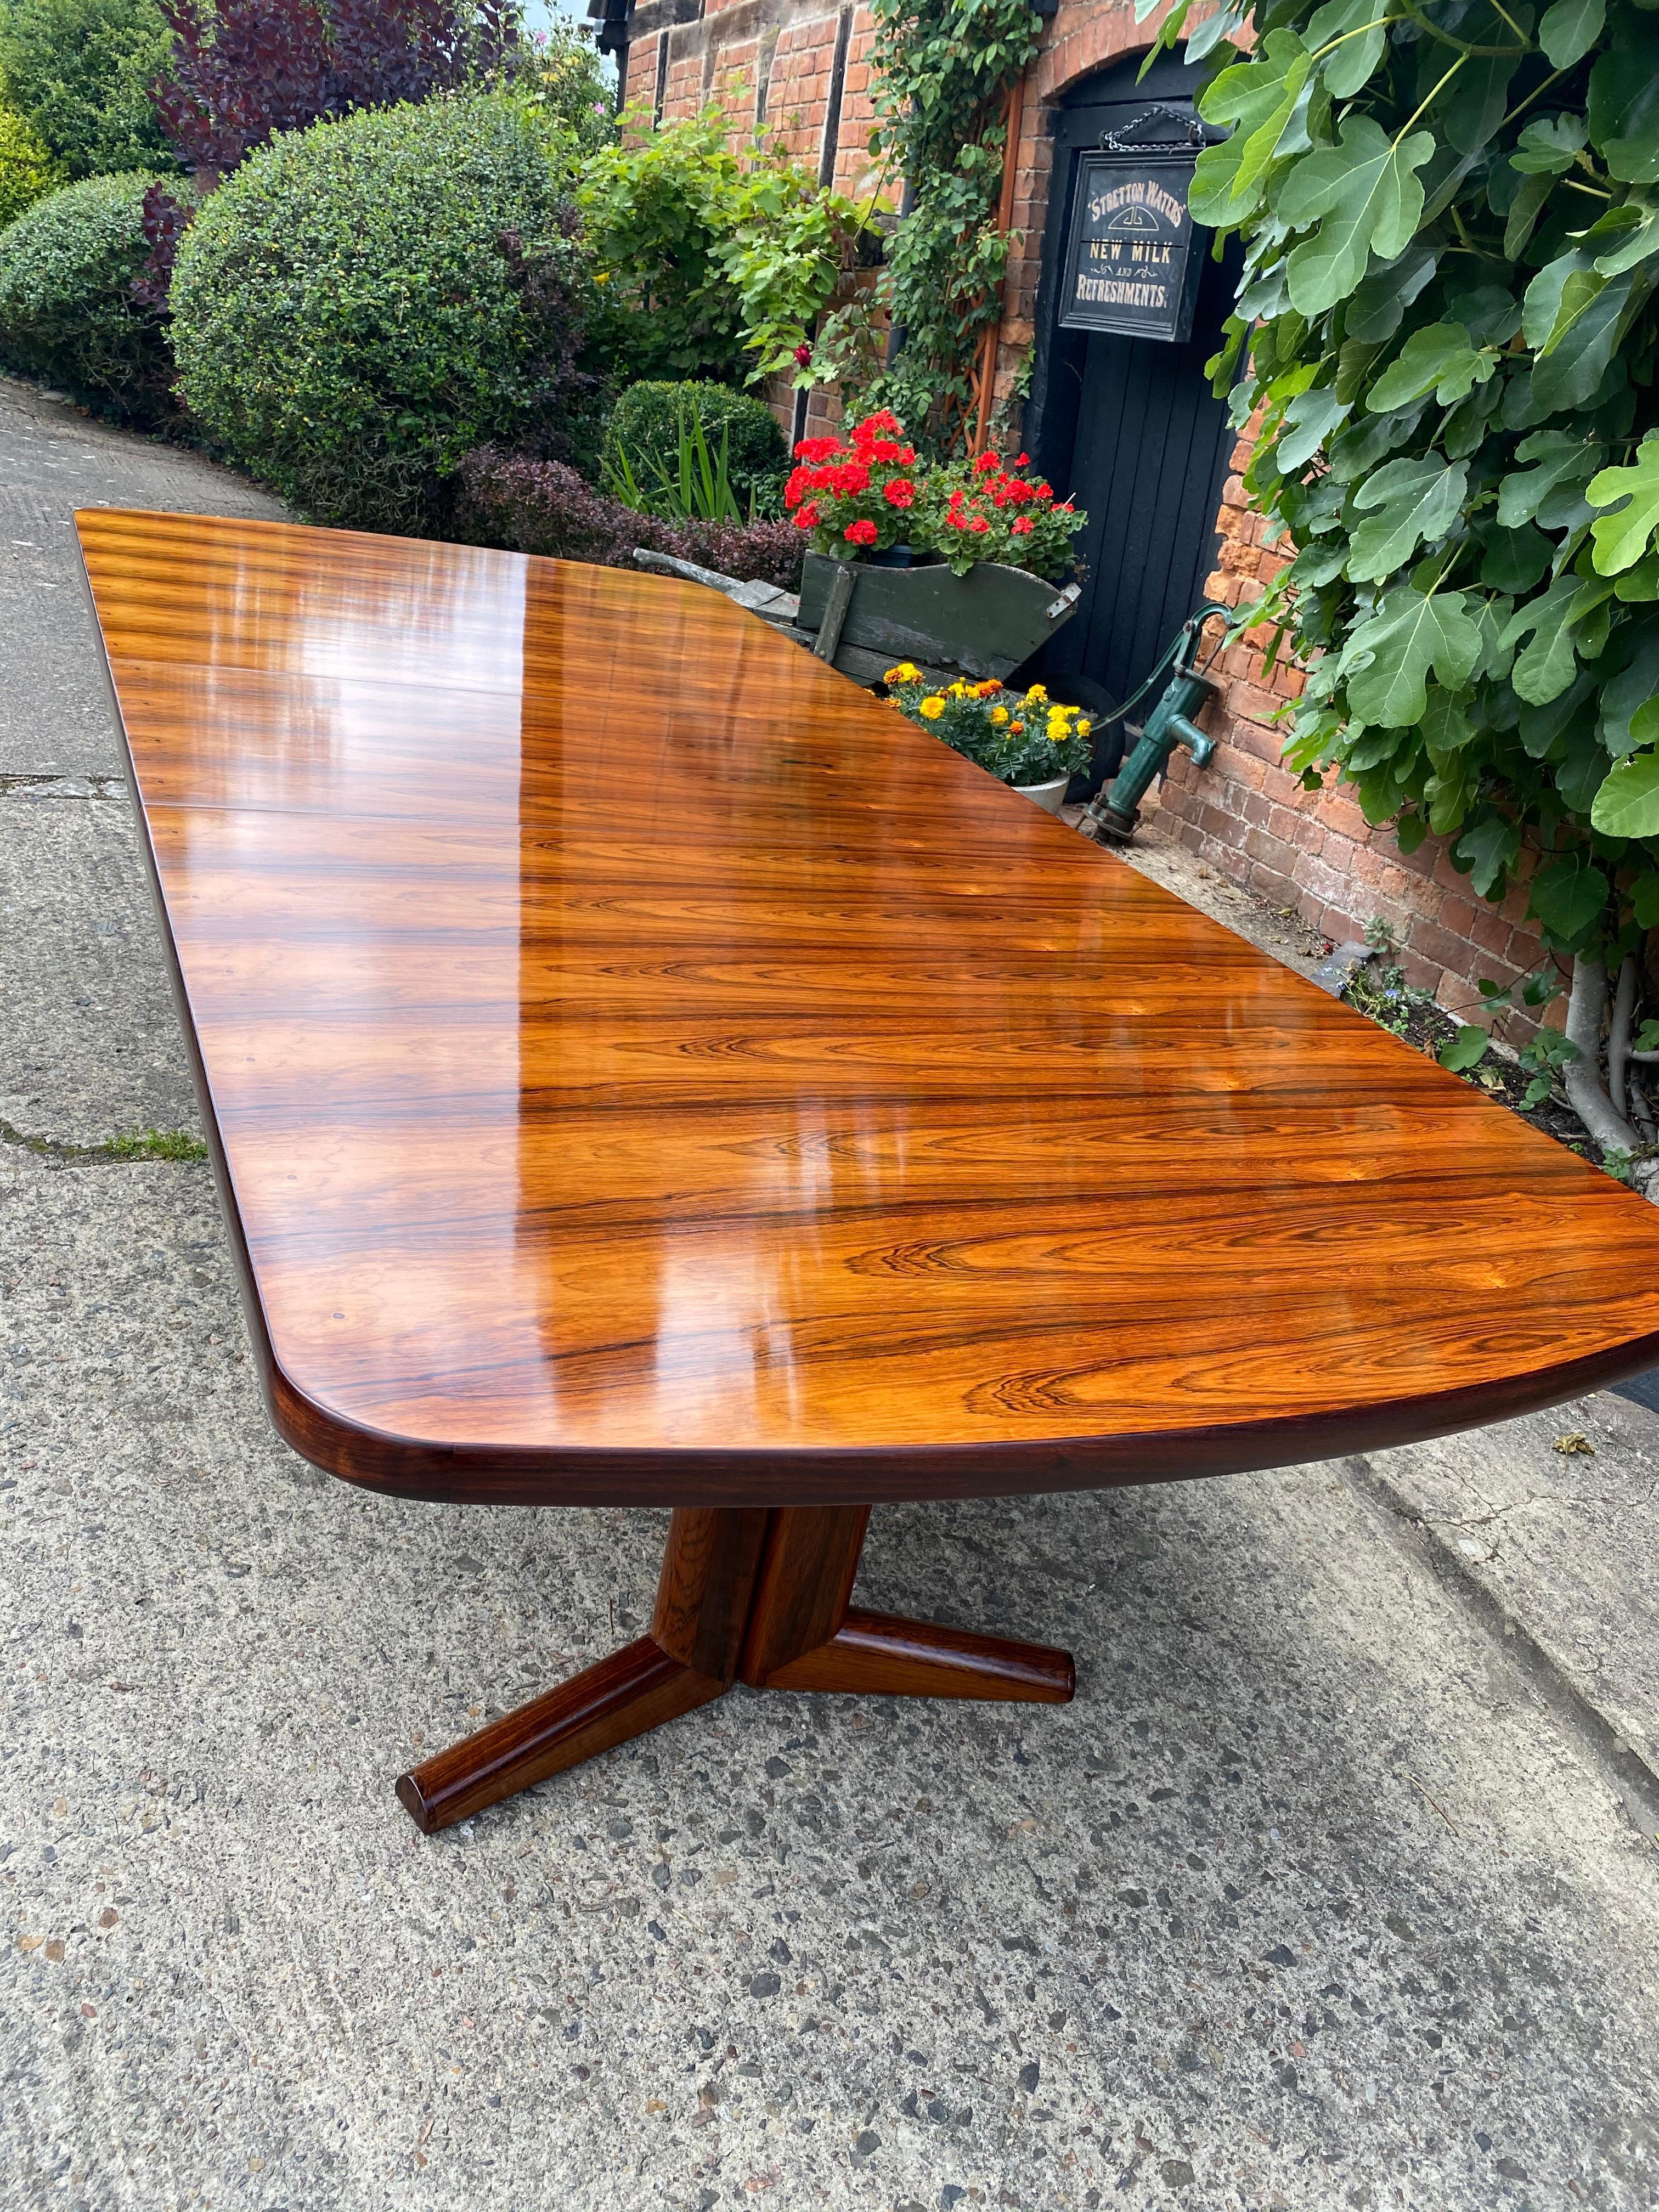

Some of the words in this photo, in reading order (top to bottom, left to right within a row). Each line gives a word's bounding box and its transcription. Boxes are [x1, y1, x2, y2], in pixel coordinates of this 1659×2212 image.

[1090, 239, 1122, 261] NEW
[1131, 240, 1172, 263] MILK
[1115, 267, 1132, 277] AND
[1076, 274, 1167, 308] REFRESHMENTS.
